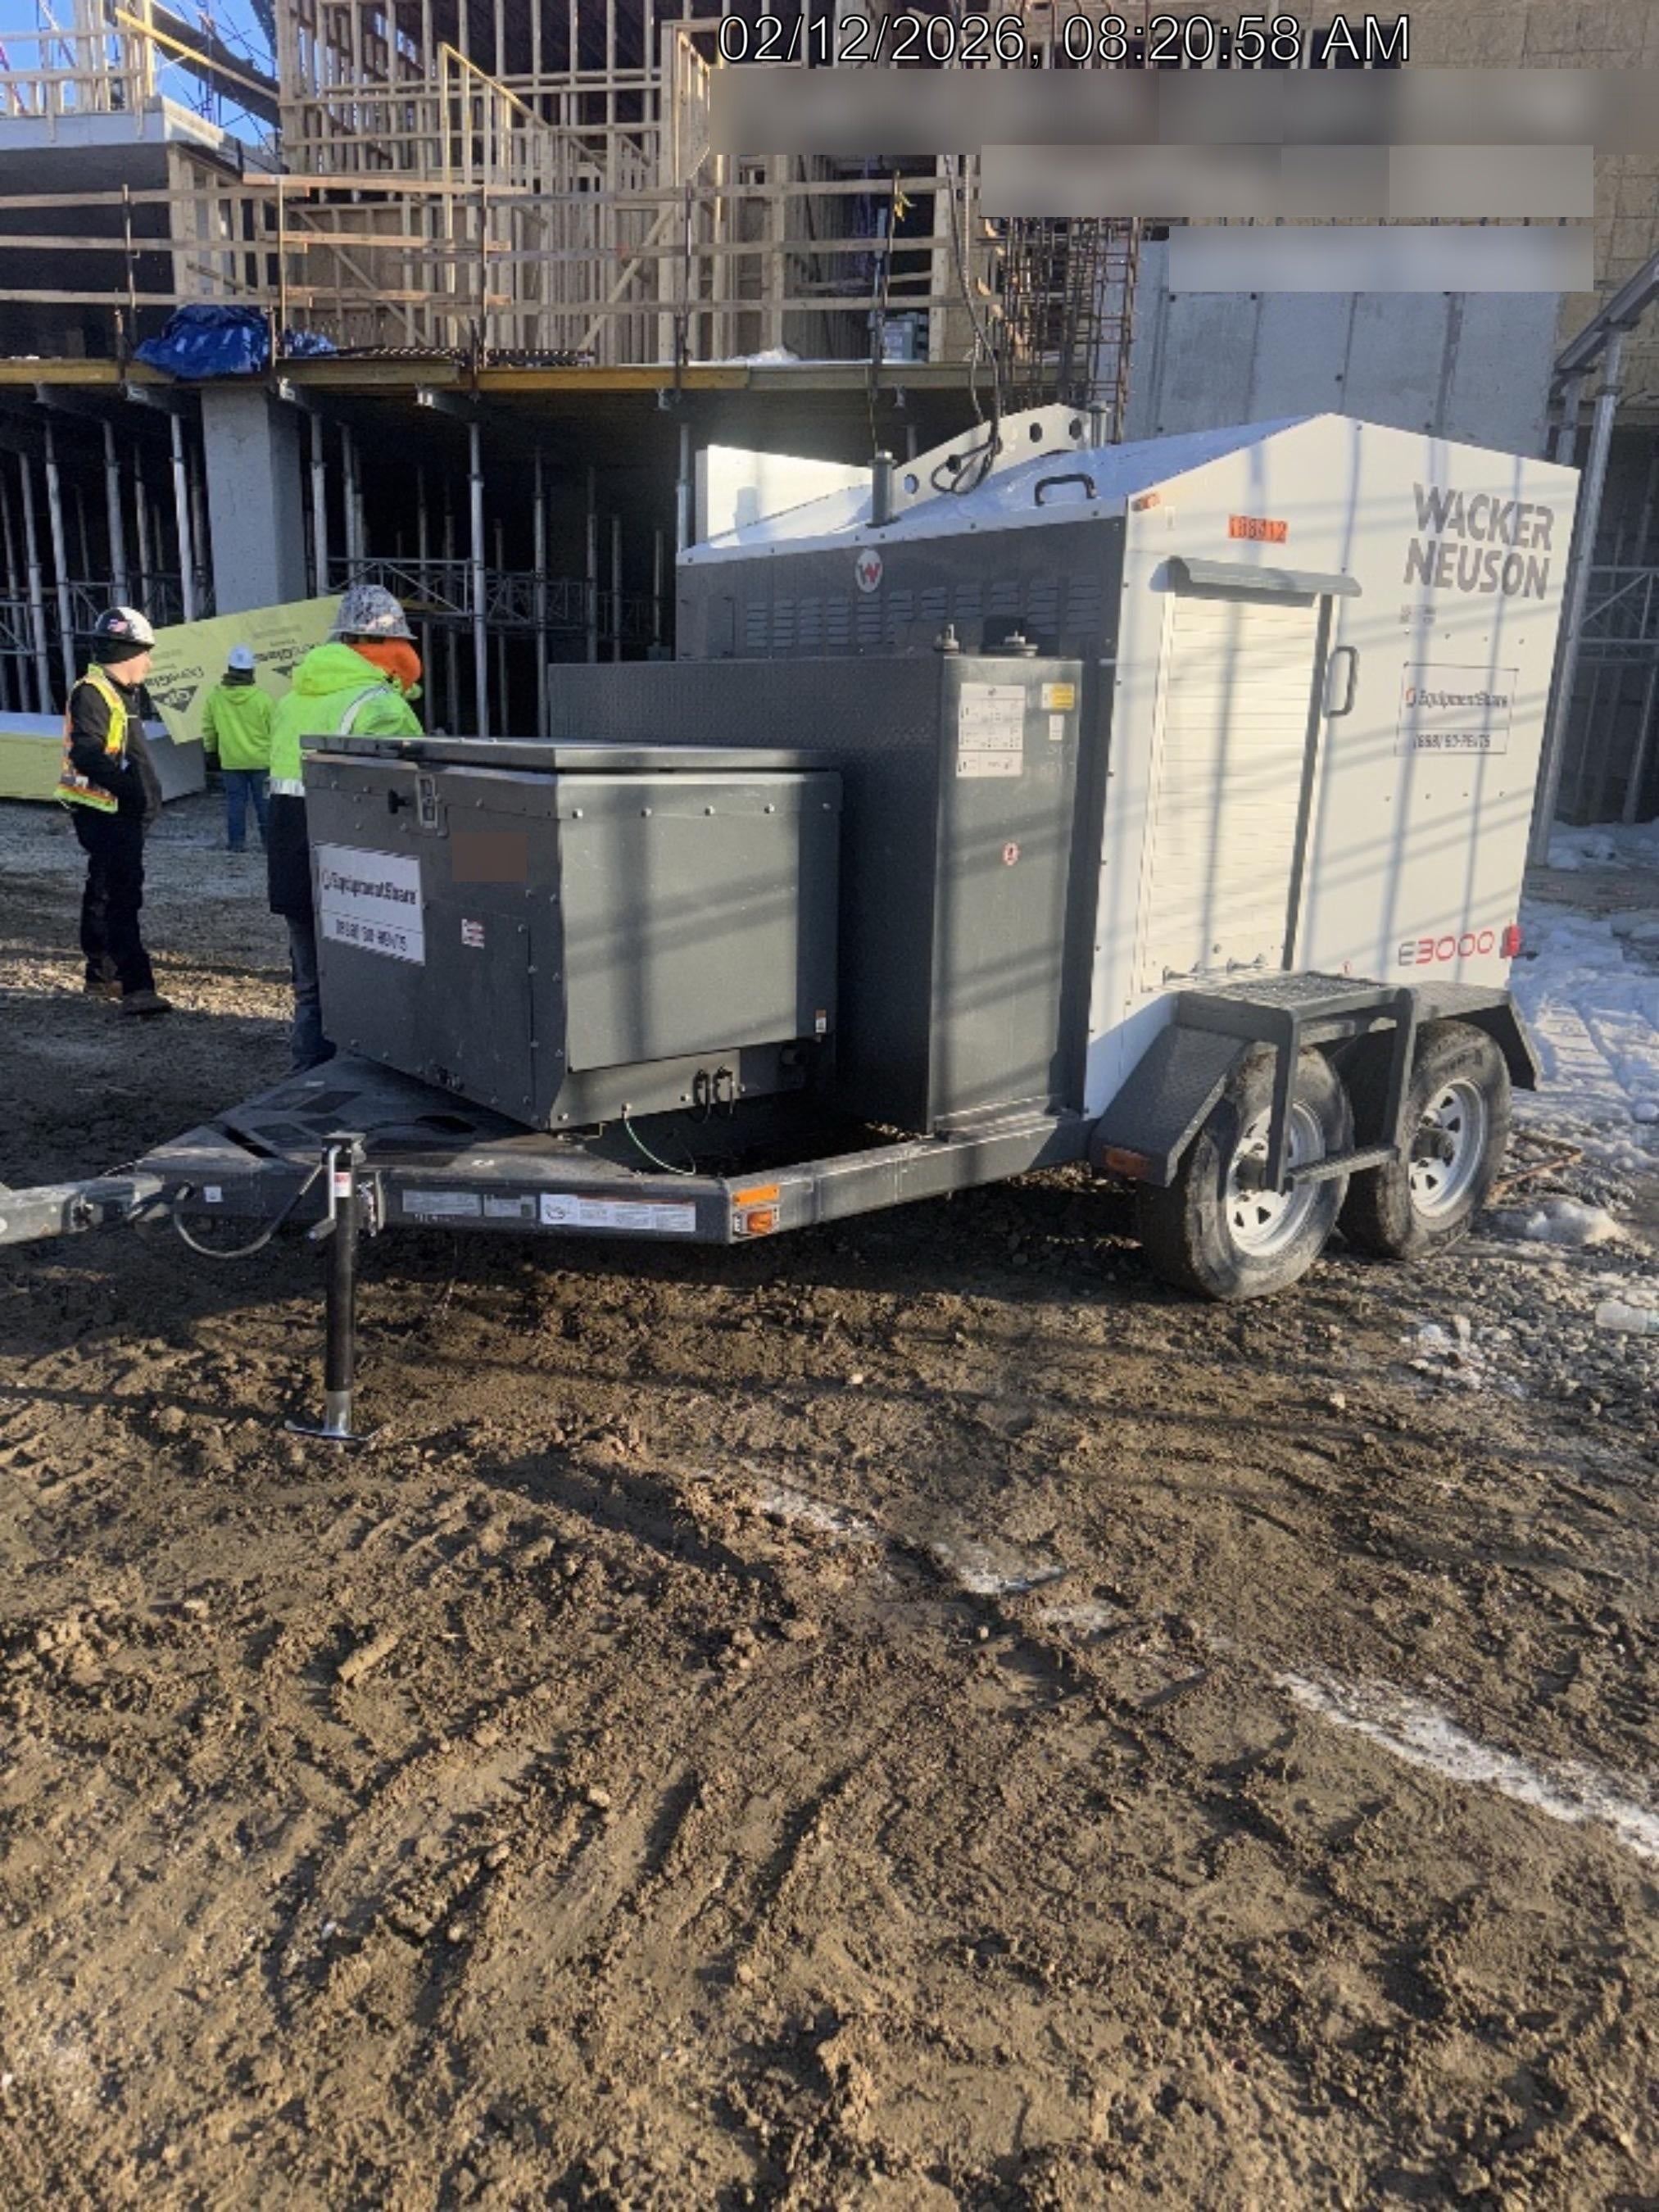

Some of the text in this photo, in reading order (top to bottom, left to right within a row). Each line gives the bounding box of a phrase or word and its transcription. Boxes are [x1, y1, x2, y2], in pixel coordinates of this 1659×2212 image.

[1413, 482, 1554, 551] WACKER
[1403, 537, 1550, 600] NEUSON
[1398, 931, 1494, 966] E3000
